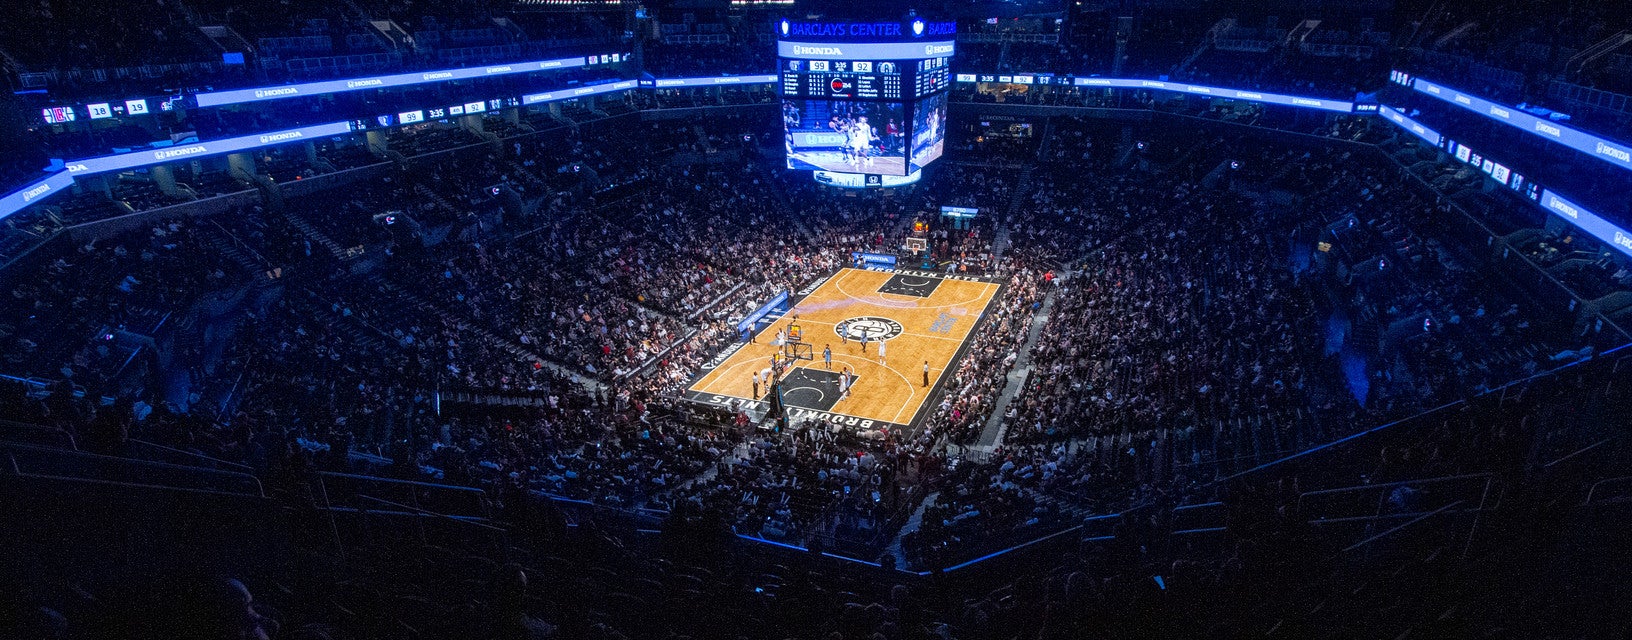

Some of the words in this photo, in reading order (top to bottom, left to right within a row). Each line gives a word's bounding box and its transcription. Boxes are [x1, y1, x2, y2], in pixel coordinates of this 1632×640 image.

[792, 23, 846, 36] BARCLAYS
[850, 23, 901, 36] CENTER
[801, 46, 843, 55] HONDA
[814, 62, 825, 70] 99
[857, 62, 868, 71] 92
[354, 79, 383, 87] HONDA
[264, 87, 298, 96] HONDA
[94, 107, 106, 116] 18
[132, 103, 143, 112] 19
[406, 113, 417, 121] 99
[429, 109, 444, 118] 3:35
[268, 131, 303, 141] HONDA
[165, 146, 207, 158] HONDA
[1602, 145, 1630, 163] HONDA
[28, 183, 51, 199] HONDA
[1555, 200, 1578, 219] HONDA
[866, 266, 938, 278] BROOKLYN
[943, 274, 980, 282] NETS
